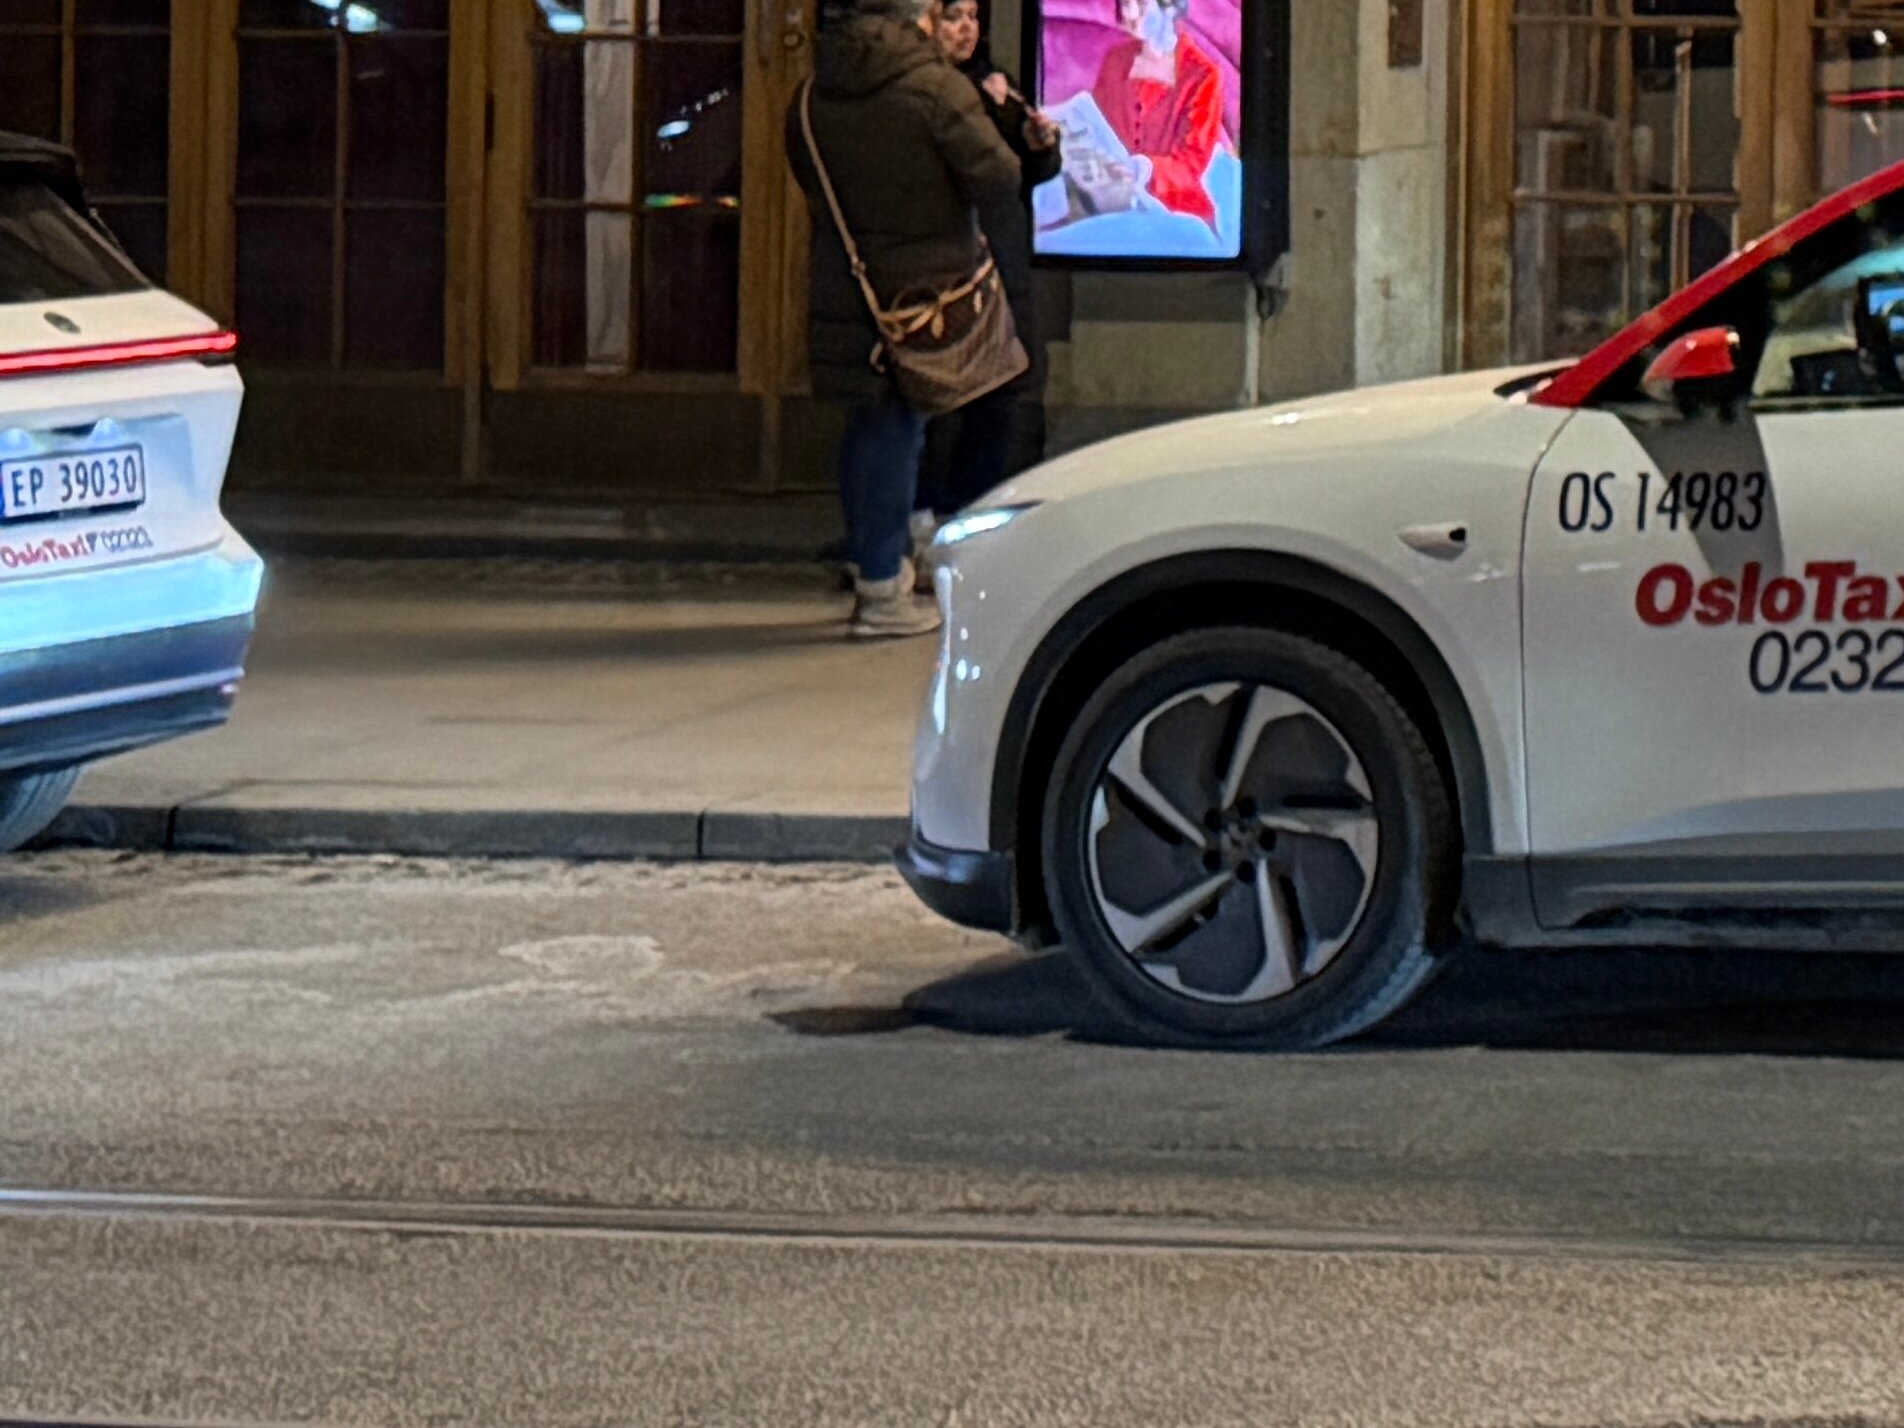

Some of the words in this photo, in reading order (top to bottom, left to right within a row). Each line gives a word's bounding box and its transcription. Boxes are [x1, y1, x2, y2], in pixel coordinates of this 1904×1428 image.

[11, 466, 44, 508] EP
[60, 454, 138, 503] 39030
[1558, 471, 1615, 533] OS
[1637, 471, 1767, 532] 14983
